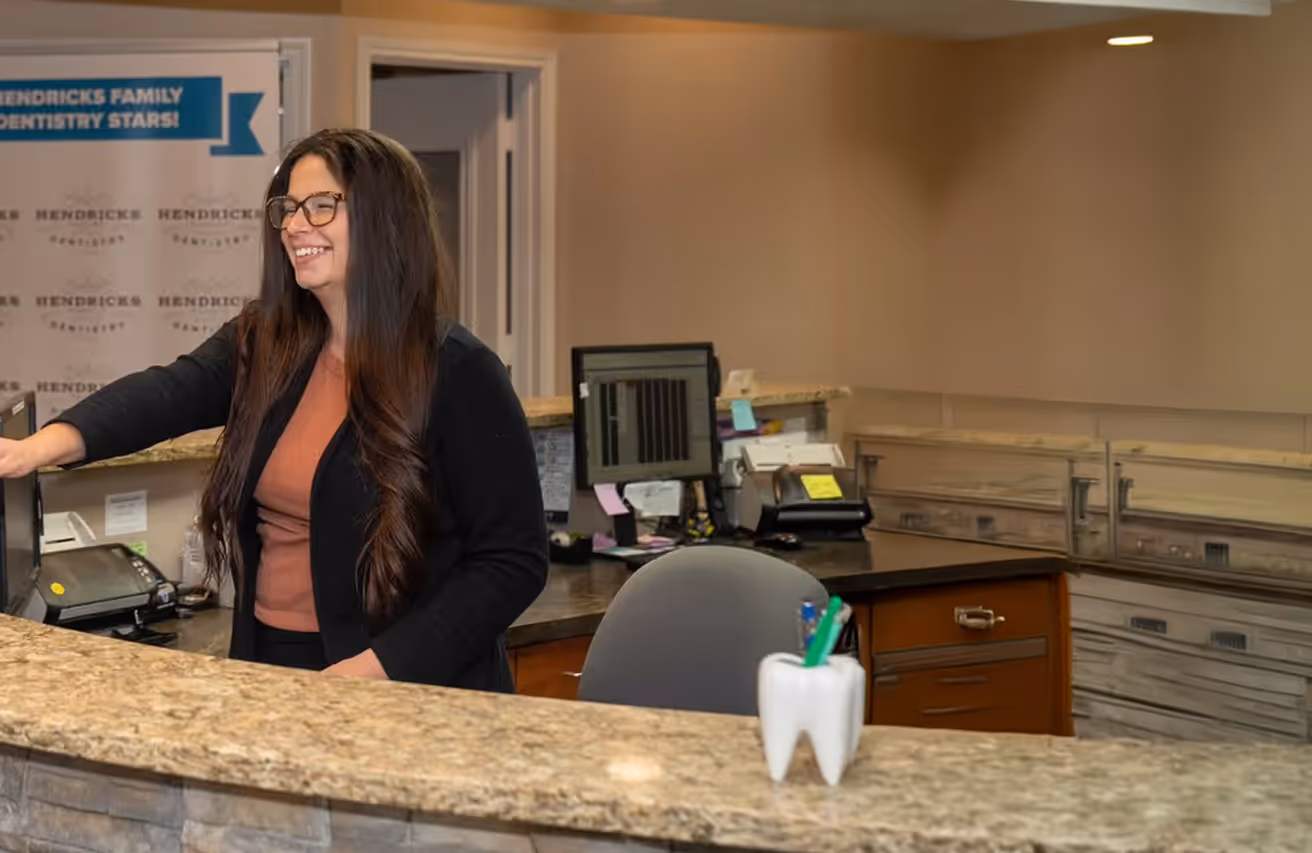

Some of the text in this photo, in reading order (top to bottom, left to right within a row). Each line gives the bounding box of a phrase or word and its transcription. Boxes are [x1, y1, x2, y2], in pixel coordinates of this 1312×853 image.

[110, 86, 183, 105] FAMILY
[107, 110, 179, 128] STARS!
[35, 209, 142, 221] HENDRICKS
[157, 208, 264, 220] HENDRICKS
[35, 295, 142, 307] HENDRICKS
[158, 296, 246, 307] HENDRIC
[37, 382, 105, 393] HENDR
